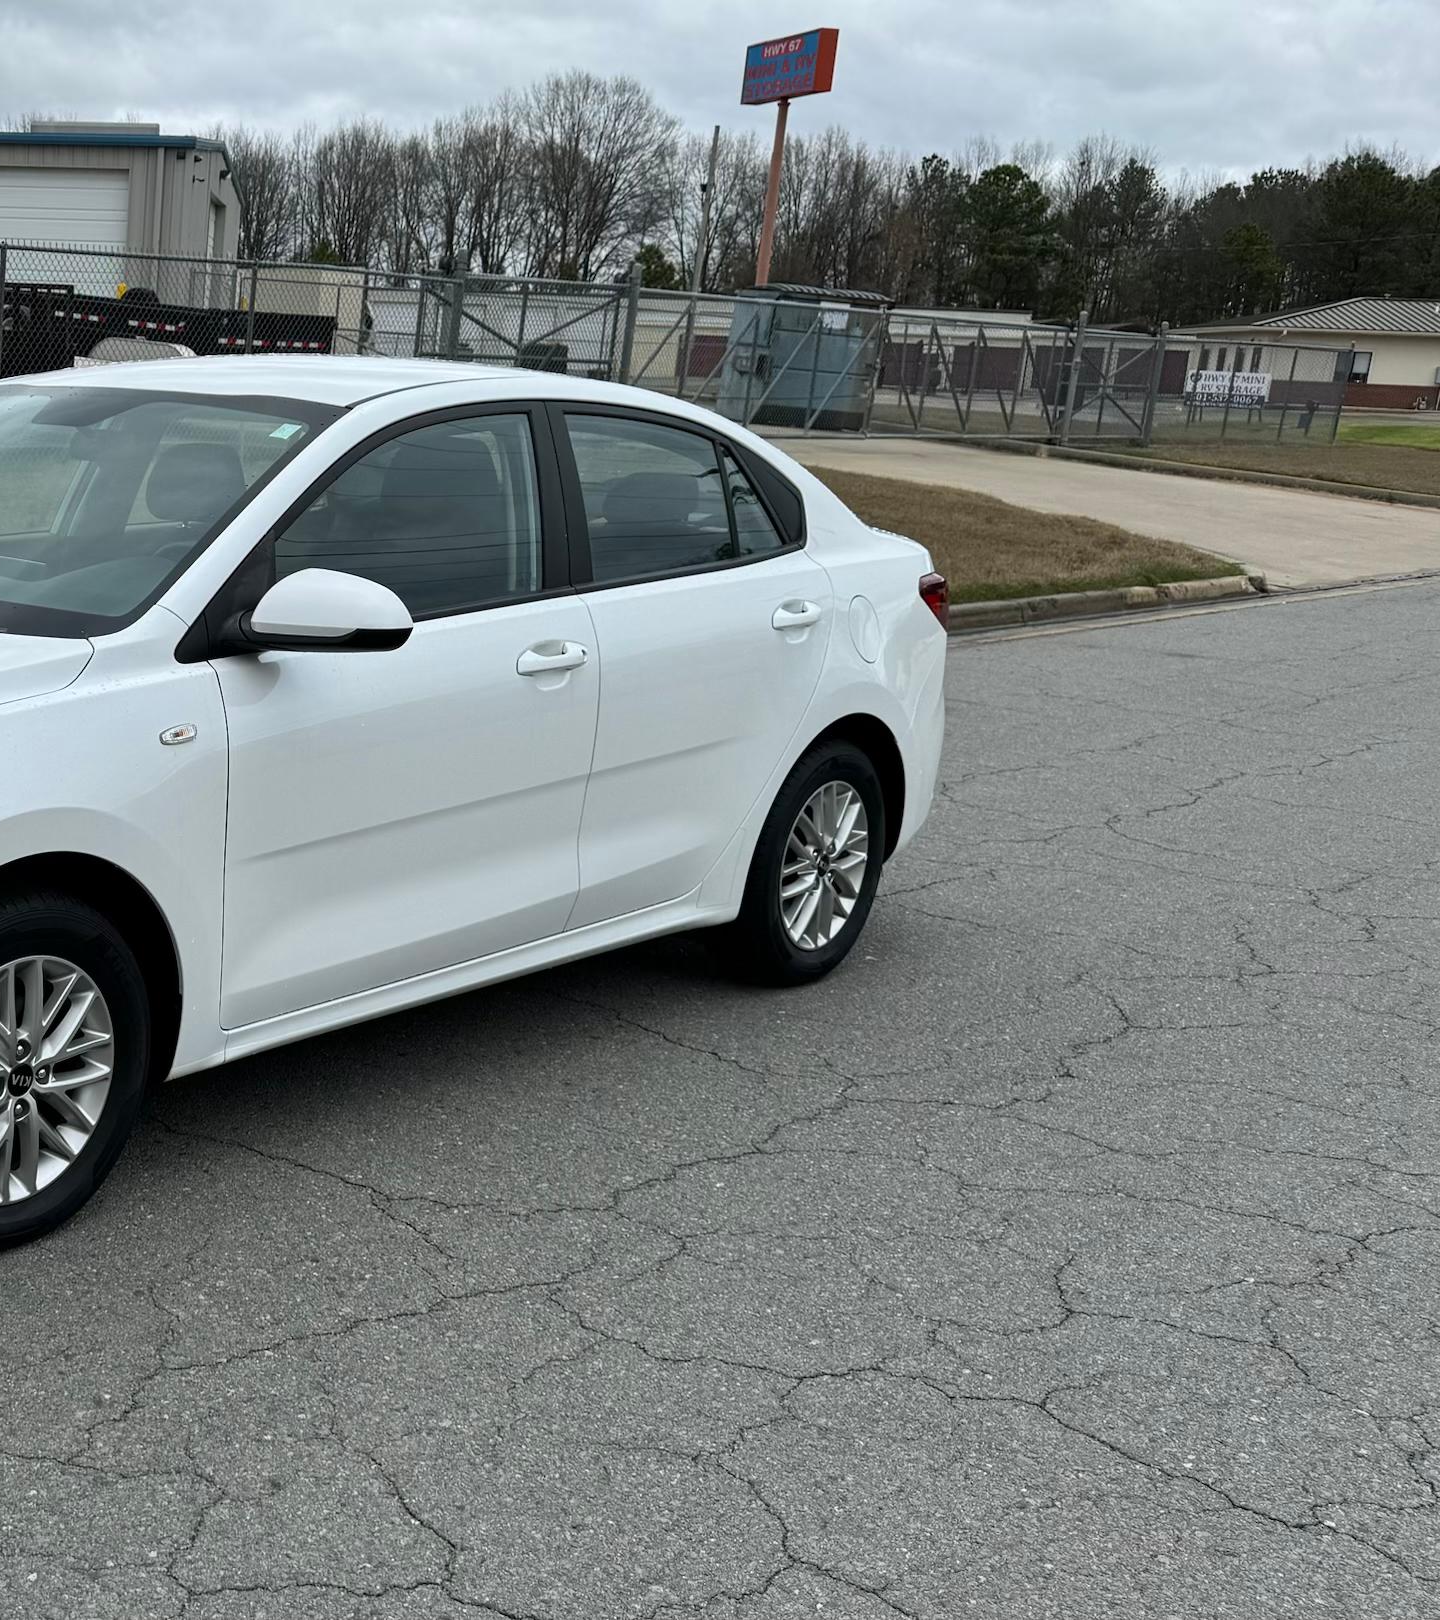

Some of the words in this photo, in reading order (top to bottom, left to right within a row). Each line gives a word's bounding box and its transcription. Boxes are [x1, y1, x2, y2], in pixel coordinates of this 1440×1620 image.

[764, 42, 788, 57] HWY
[788, 39, 802, 52] 67
[747, 63, 776, 78] MINI
[795, 53, 816, 70] RV
[745, 74, 810, 97] STORAGE
[1200, 383, 1214, 392] RV
[1203, 374, 1227, 382] HWY
[1241, 375, 1266, 385] MINI
[12, 1073, 32, 1087] KIA
